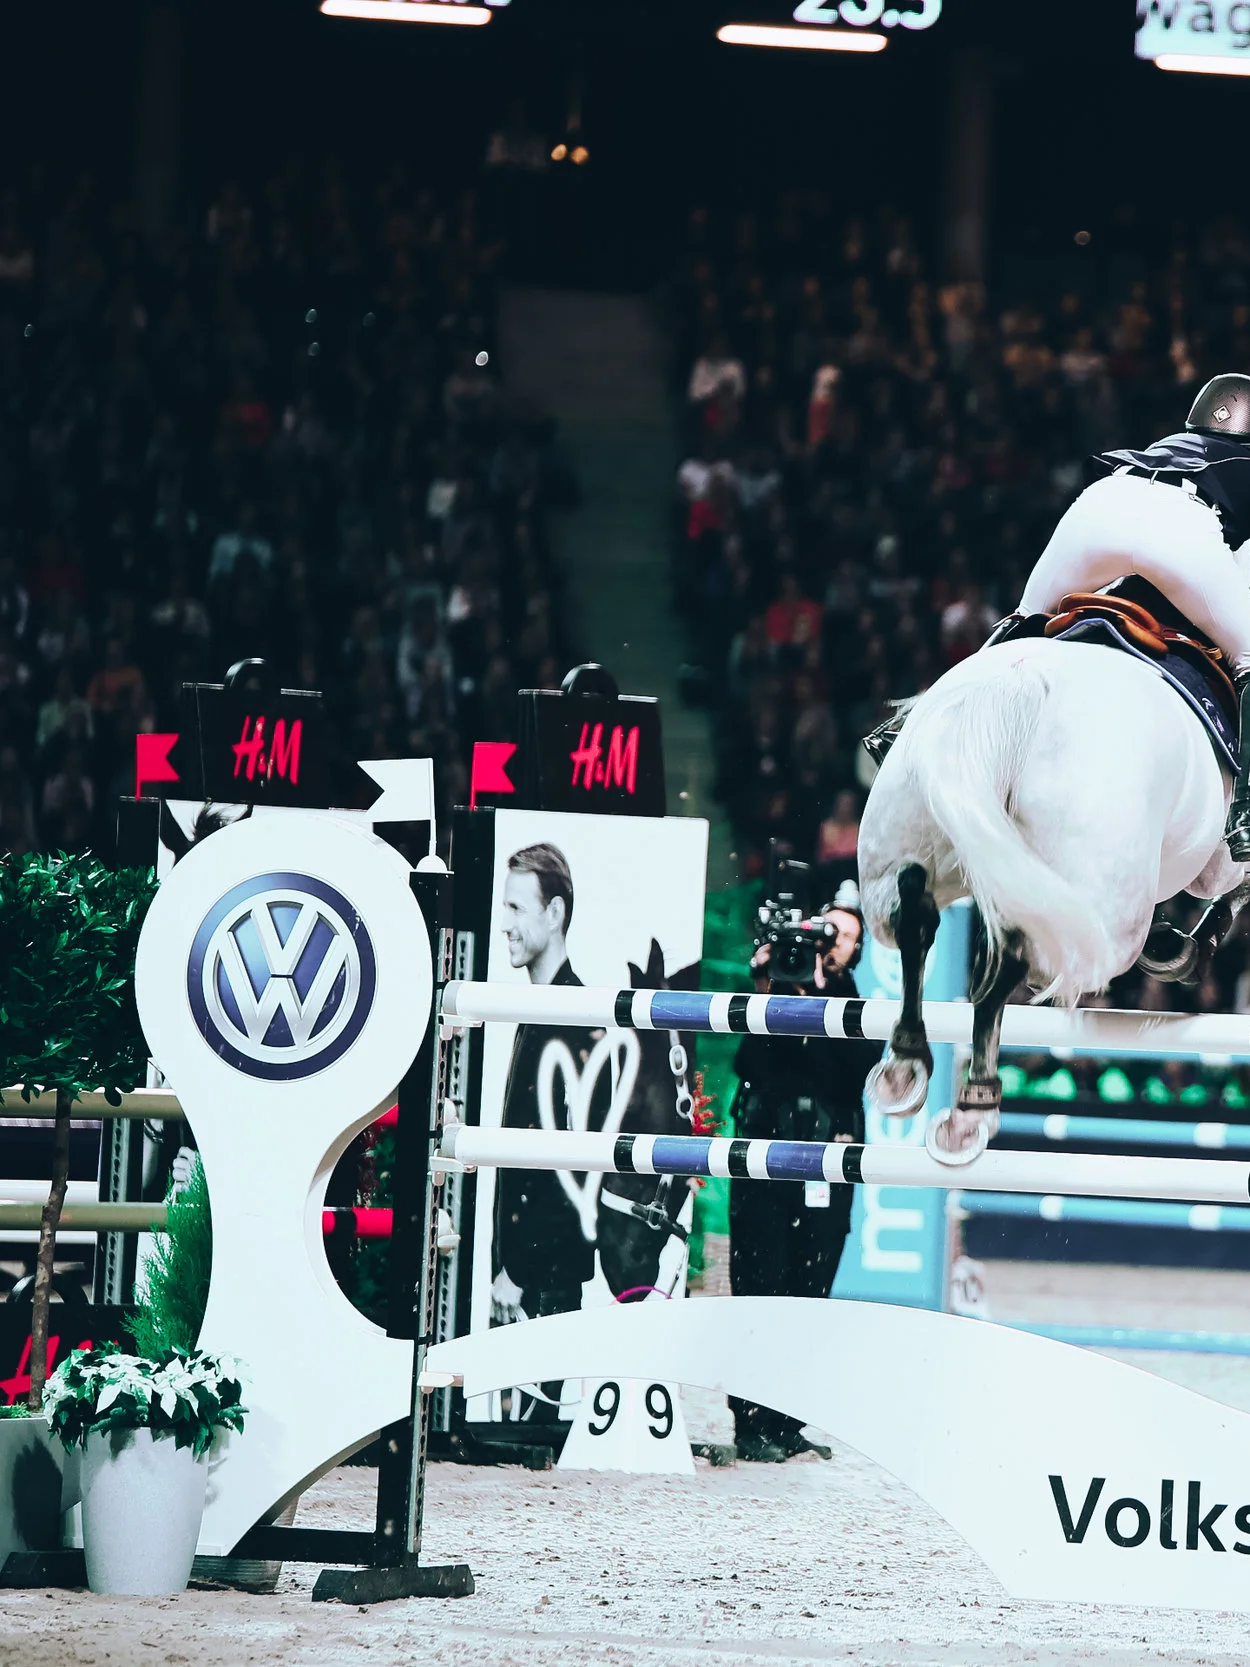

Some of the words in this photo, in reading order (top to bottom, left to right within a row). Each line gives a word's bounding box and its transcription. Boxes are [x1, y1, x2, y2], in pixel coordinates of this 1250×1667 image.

[232, 714, 303, 786] H&M
[569, 720, 642, 796] H&M
[588, 1381, 621, 1436] 9
[645, 1383, 674, 1439] 9
